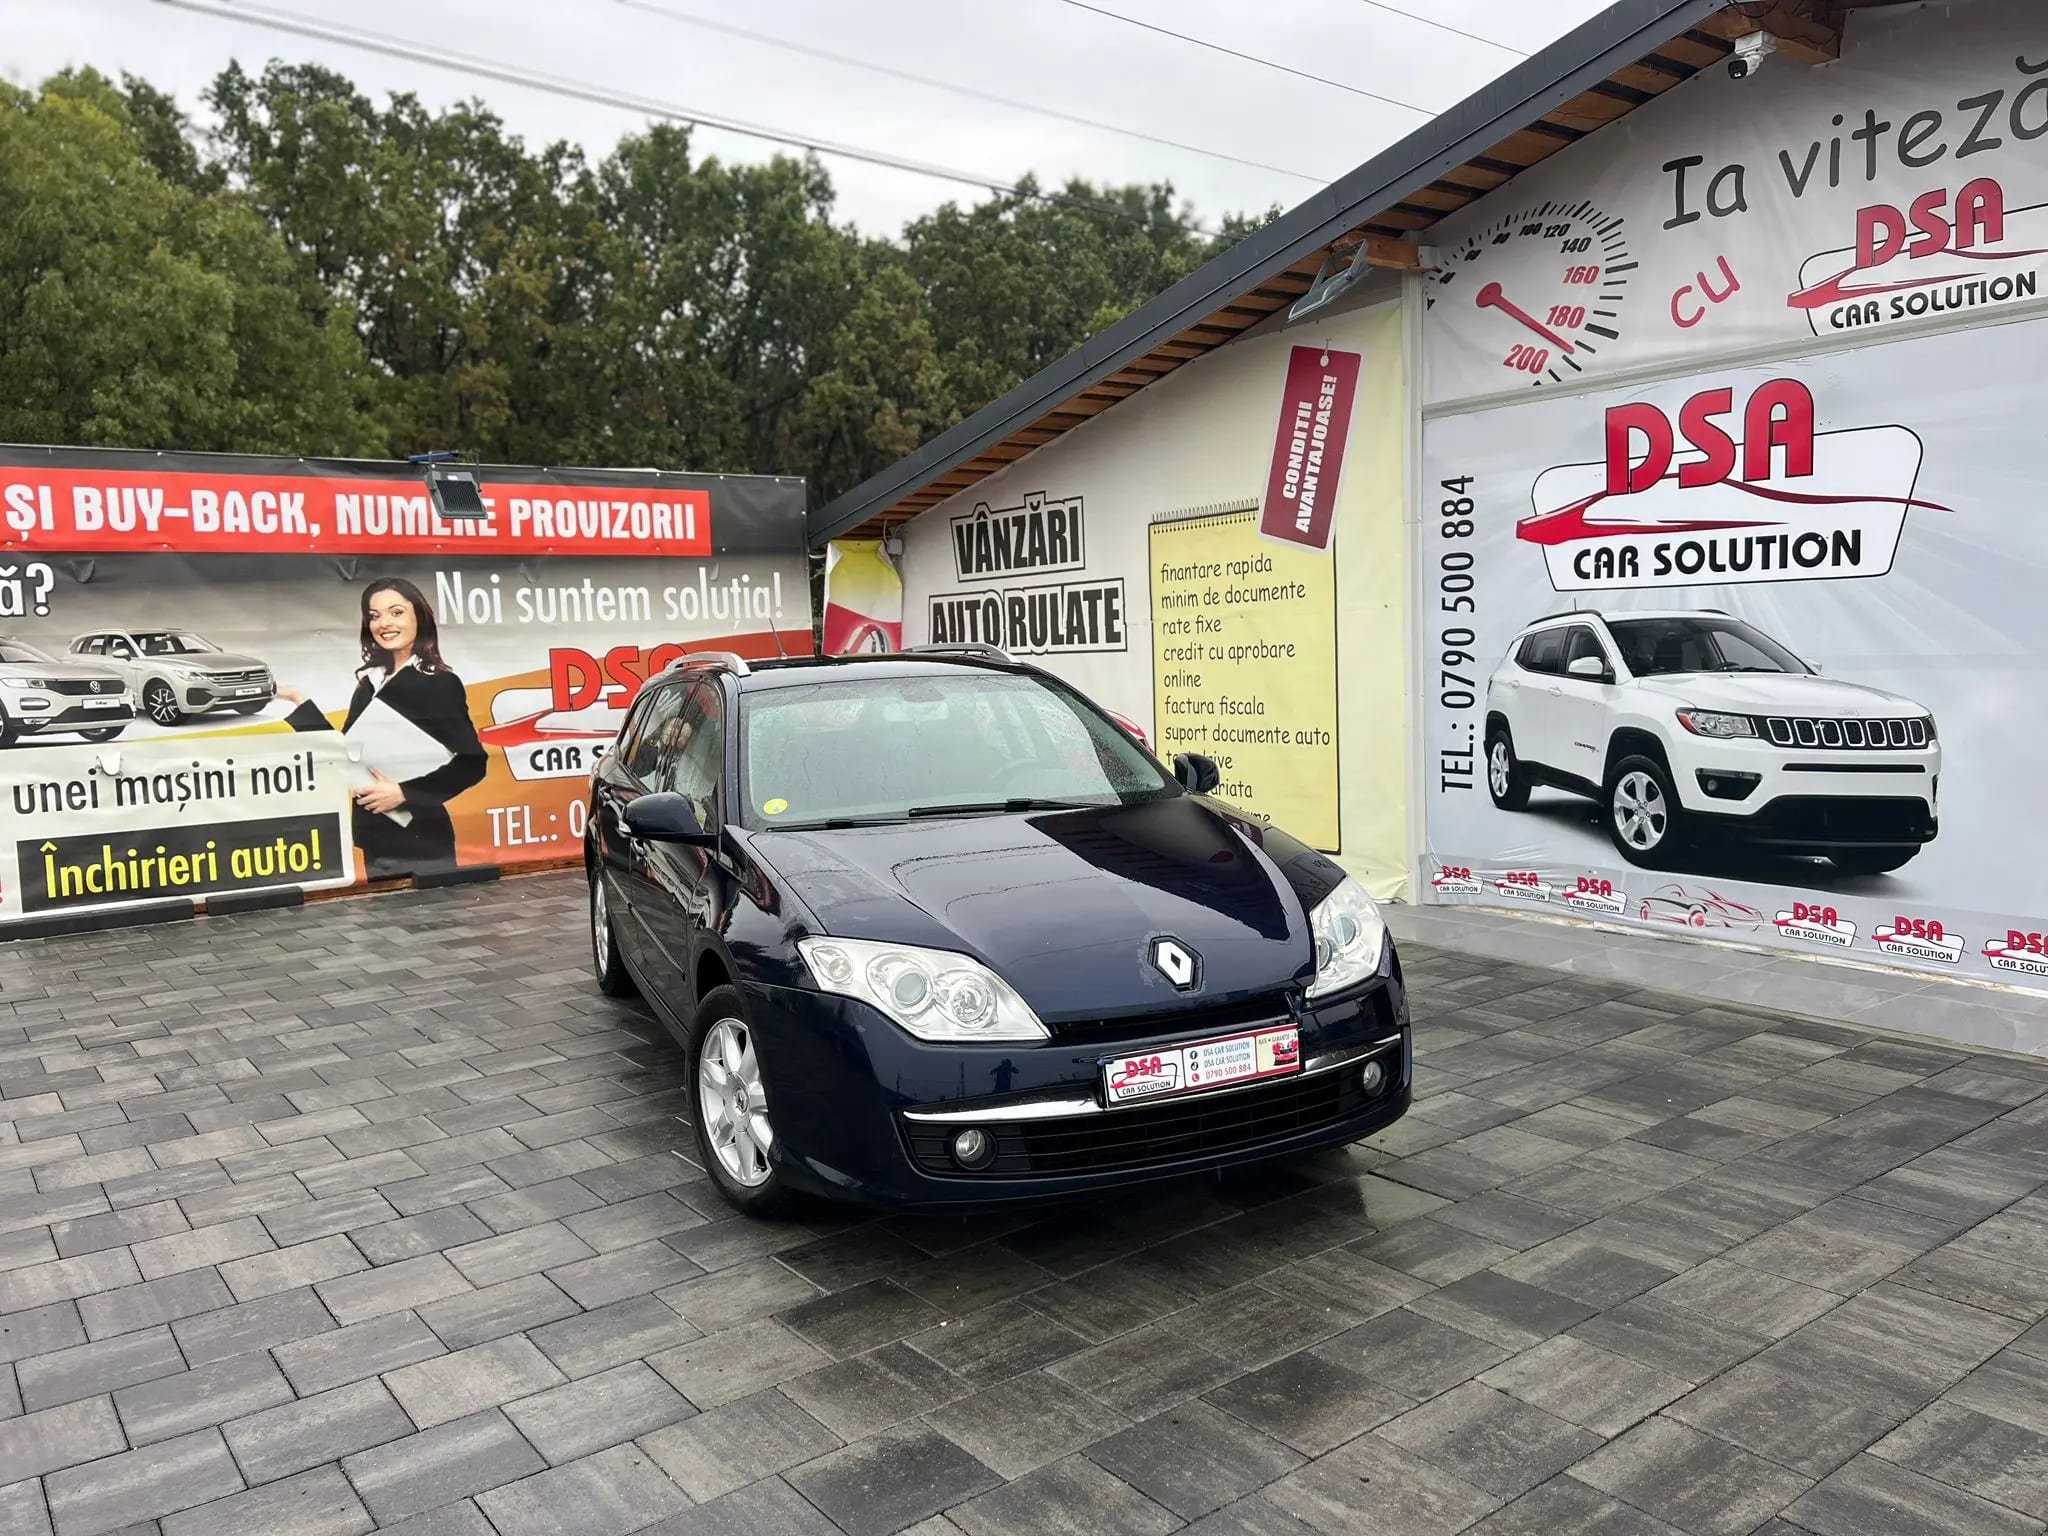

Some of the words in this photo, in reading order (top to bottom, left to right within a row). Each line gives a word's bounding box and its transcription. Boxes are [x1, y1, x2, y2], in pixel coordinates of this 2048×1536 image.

[1663, 154, 1748, 229] Ia
[1543, 223, 1571, 239] 120
[1856, 178, 2004, 270] DSA
[1560, 237, 1592, 254] 140
[1562, 265, 1600, 285] 160
[1671, 256, 1741, 328] cu
[1830, 298, 1881, 329] CAR
[1890, 271, 2037, 314] SOLUTION
[1546, 305, 1586, 329] 180
[1503, 343, 1550, 375] 200
[1605, 378, 1814, 495] DSA
[1295, 374, 1338, 534] AVANTAJOASE!
[5, 484, 53, 542] ȘI
[509, 499, 696, 541] PROVIZORII
[1440, 474, 1475, 539] 884
[955, 501, 1080, 575] VÂNZĂRI
[1573, 545, 1640, 580] CAR
[1654, 528, 1862, 576] SOLUTION
[1161, 562, 1222, 584] finantare
[1226, 553, 1273, 581] rapida
[1440, 552, 1475, 613] 500
[435, 571, 501, 626] Noi
[517, 577, 652, 624] suntem
[663, 567, 784, 629] soluția!
[1161, 589, 1199, 610] minim
[1203, 586, 1221, 606] de
[1224, 581, 1307, 604] documente
[932, 597, 1004, 649] AUTO
[1006, 587, 1122, 647] RULATE
[1162, 617, 1191, 636] rate
[1195, 614, 1223, 634] fixe
[1163, 642, 1204, 662] credit
[1208, 647, 1224, 661] cu
[1227, 640, 1297, 665] aprobare
[549, 643, 688, 713] DS
[1163, 669, 1202, 688] online
[1440, 627, 1476, 709] 0790
[1164, 695, 1215, 716] factura
[1219, 695, 1266, 716] fiscala
[1165, 726, 1208, 746] suport
[1211, 723, 1291, 745] documente
[1295, 727, 1331, 746] auto
[530, 746, 582, 772] CAR
[1440, 722, 1474, 793] TEL.:
[13, 767, 98, 815] unei
[115, 760, 237, 812] mașini
[251, 752, 316, 794] noi!
[486, 805, 558, 847] TEL.:
[40, 840, 218, 898] Închirieri
[231, 828, 322, 879] auto!
[1441, 864, 1472, 880] DSA
[1506, 871, 1540, 887] DSA
[1577, 876, 1612, 897] DSA
[1516, 890, 1546, 900] SOLUTION
[1572, 899, 1585, 907] CAR
[1586, 901, 1620, 912] SOLUTION
[1793, 902, 1838, 927] DSA
[1785, 928, 1801, 938] CAR
[1802, 930, 1846, 945] SOLUTION
[1894, 916, 1943, 941] DSA
[1886, 943, 1904, 953] CAR
[1905, 945, 1953, 961] SOLUTION
[2007, 929, 2048, 955] DS
[1997, 959, 2017, 969] CAR
[1203, 1048, 1214, 1057] DSA
[1214, 1046, 1225, 1055] CAR
[1225, 1041, 1250, 1053] SOLUTION
[1215, 1057, 1225, 1066] CAR
[1125, 1056, 1163, 1078] DSA
[1205, 1069, 1223, 1079] 0790
[1224, 1066, 1237, 1076] 500
[1238, 1063, 1251, 1073] 884
[1122, 1087, 1136, 1095] CAR
[1137, 1080, 1171, 1092] SOLUTION
